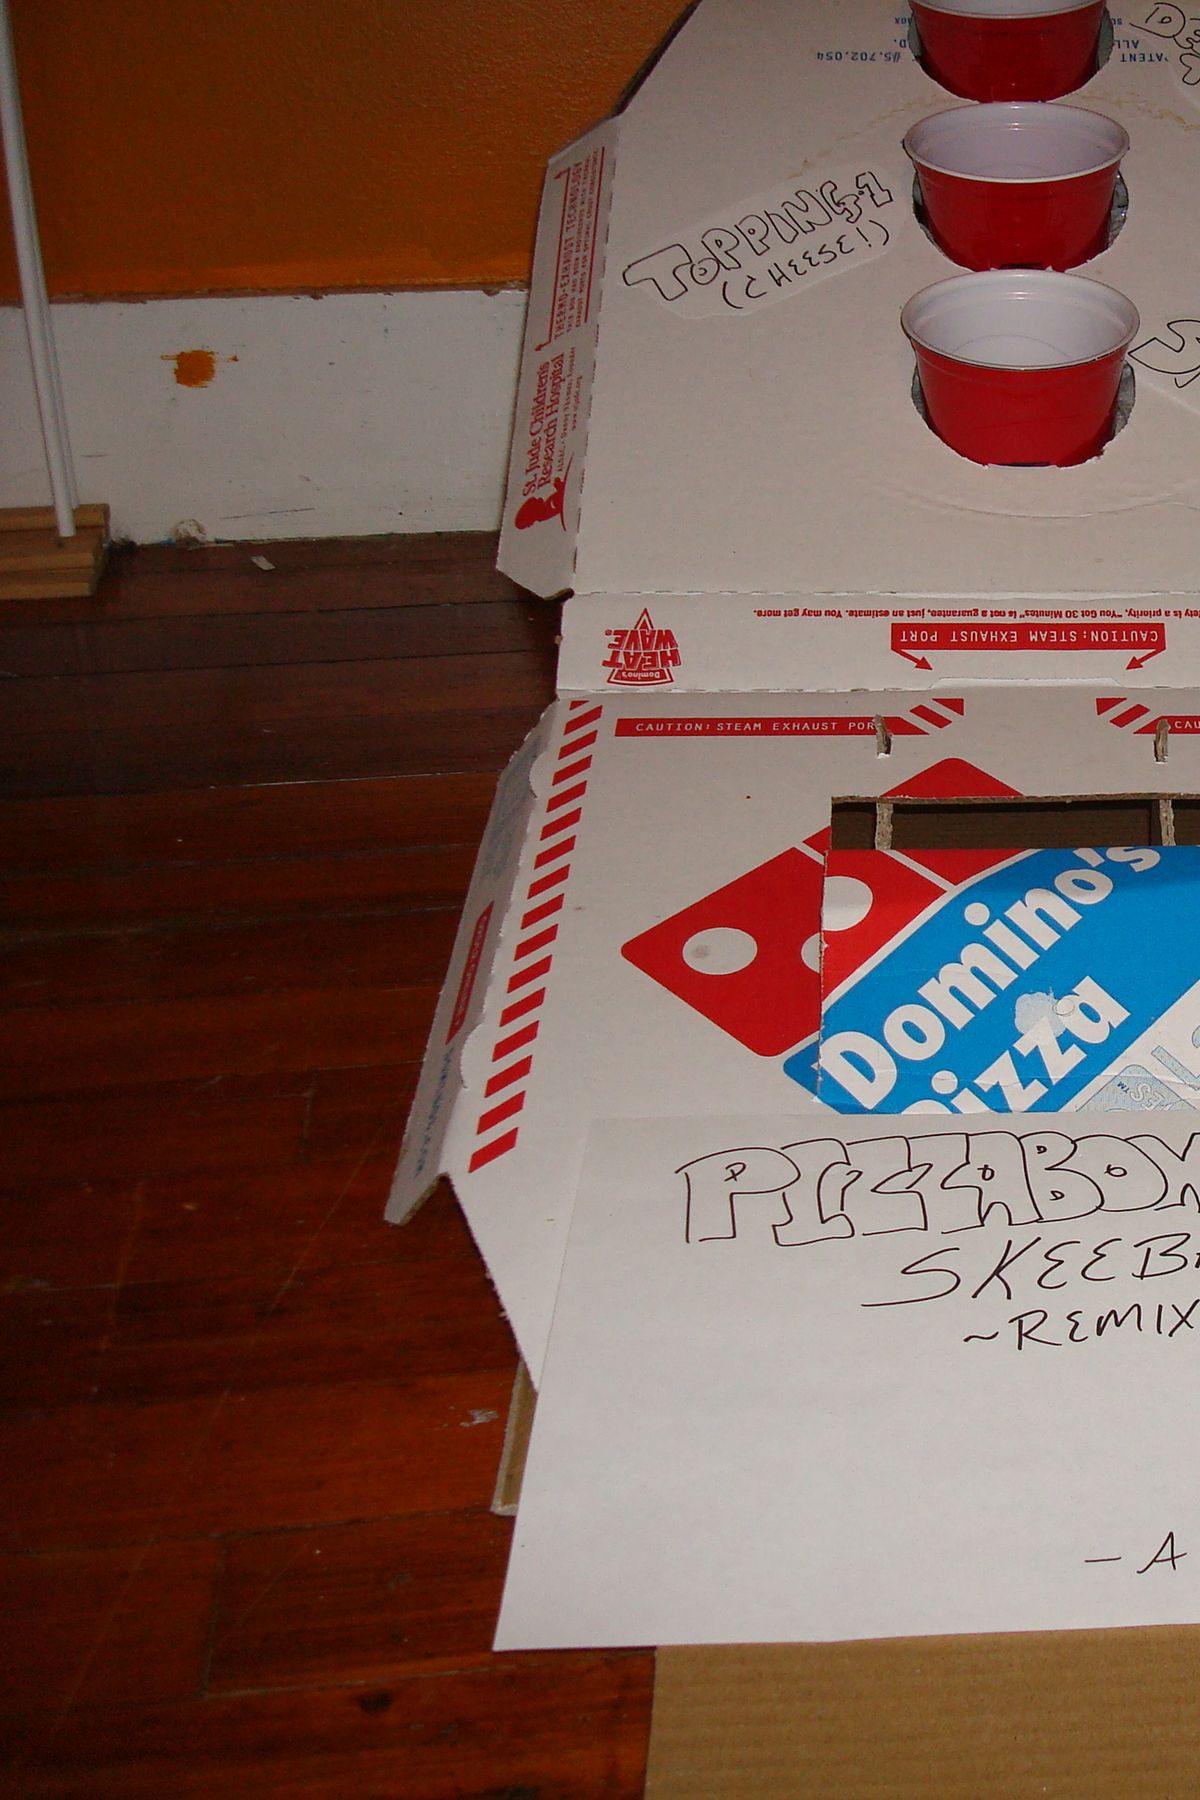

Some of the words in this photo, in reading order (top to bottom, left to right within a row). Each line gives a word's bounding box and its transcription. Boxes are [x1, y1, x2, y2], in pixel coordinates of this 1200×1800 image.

[1120, 52, 1168, 62] ATENT
[545, 352, 565, 418] Hospital
[525, 436, 541, 475] Jude
[538, 418, 558, 490] Research
[754, 609, 782, 619] more.
[783, 609, 800, 619] get
[802, 609, 822, 619] may
[824, 609, 843, 619] You
[846, 609, 890, 619] estimate.
[892, 610, 904, 618] an
[907, 608, 925, 619] just
[928, 608, 979, 619] guarantee,
[990, 609, 1006, 619] not
[1008, 609, 1018, 619] is
[1065, 609, 1079, 619] 30
[1081, 609, 1097, 619] Got
[1125, 608, 1162, 619] priority,
[1173, 609, 1182, 619] is
[607, 629, 679, 651] WAVE
[901, 631, 938, 642] PORT
[950, 631, 1018, 642] EXHAUST
[602, 649, 682, 670] HEAT
[772, 722, 838, 732] EXHAUST
[848, 721, 875, 731] POR
[811, 846, 1161, 1110] Domino's
[1136, 1531, 1188, 1575] A
